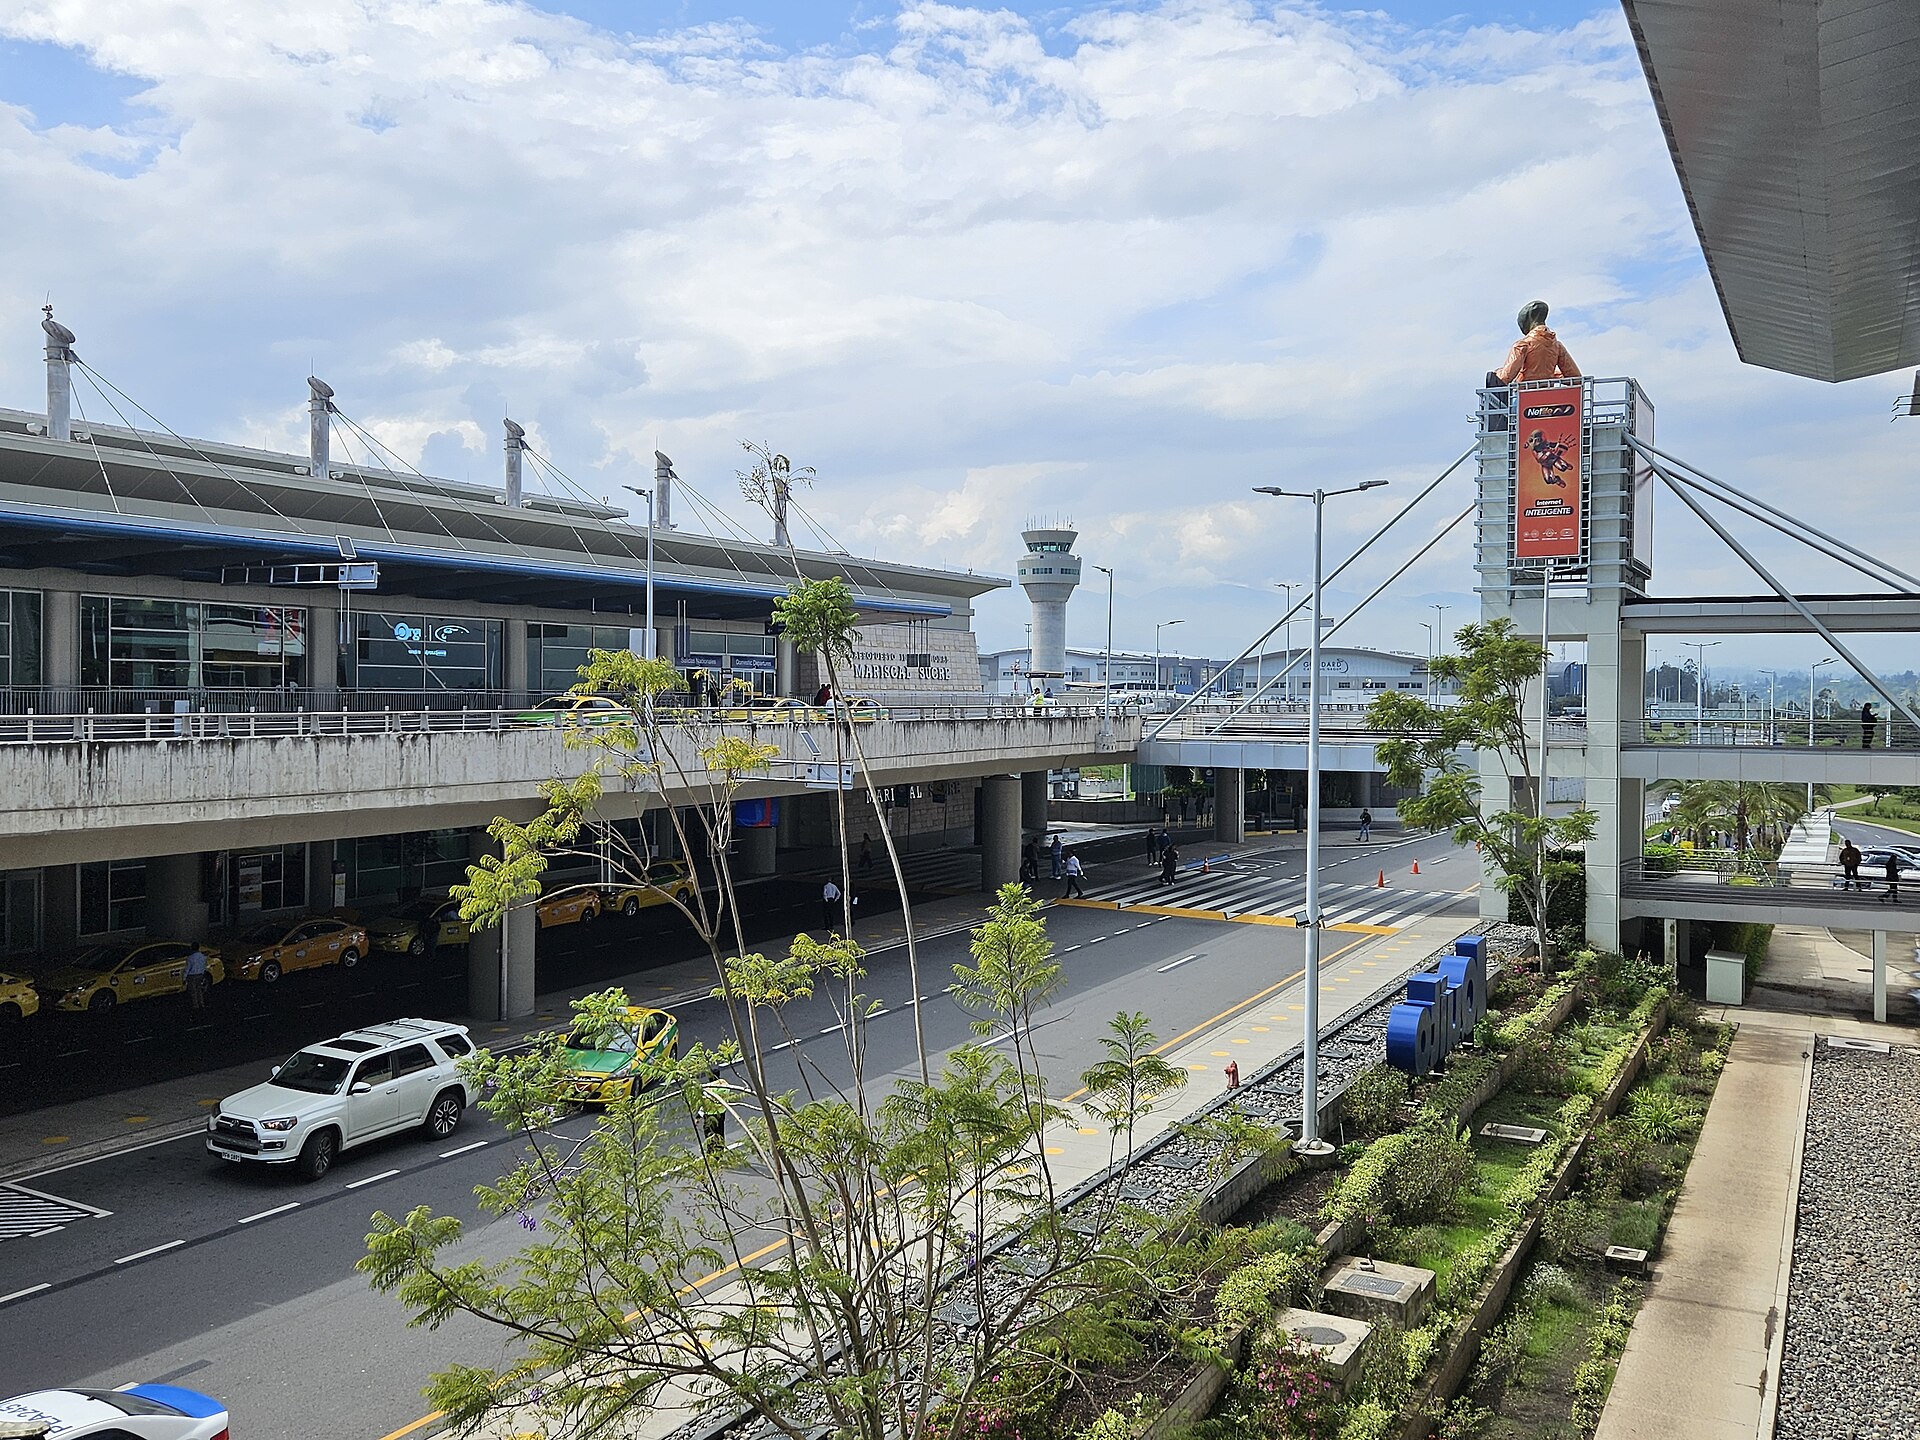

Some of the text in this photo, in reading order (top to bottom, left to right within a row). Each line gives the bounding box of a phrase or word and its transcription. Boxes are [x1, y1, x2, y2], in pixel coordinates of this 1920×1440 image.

[1525, 507, 1571, 517] INTELIGENTE
[735, 658, 772, 667] Domestic Departures
[853, 664, 951, 680] MARISCAL SUCRE
